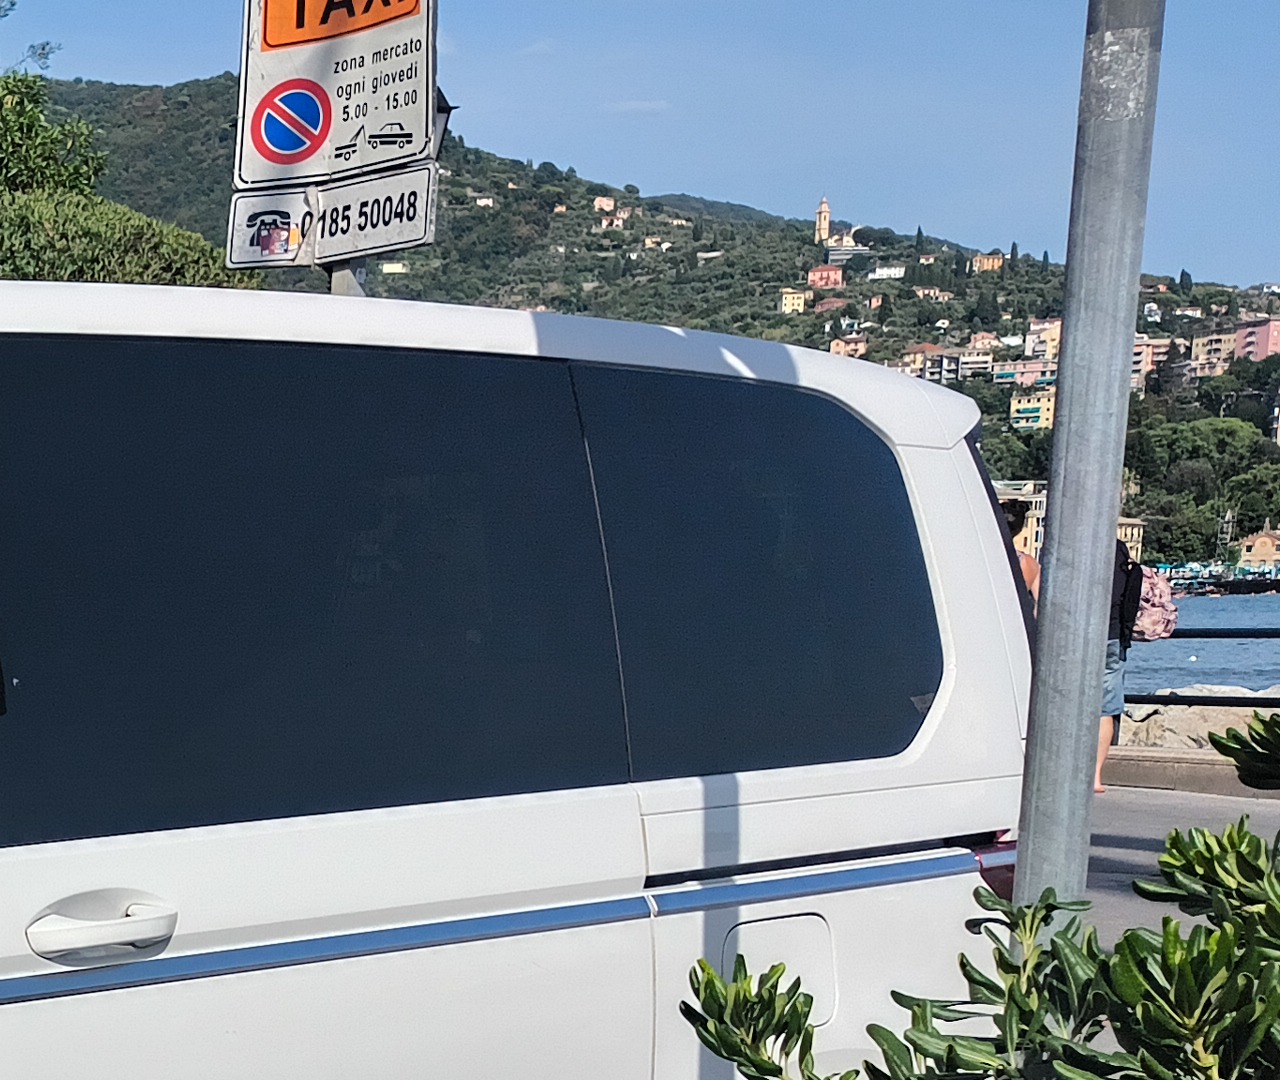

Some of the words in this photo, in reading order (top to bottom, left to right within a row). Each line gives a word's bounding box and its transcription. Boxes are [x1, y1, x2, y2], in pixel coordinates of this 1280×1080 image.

[333, 55, 365, 75] zona
[371, 37, 423, 65] mercato
[336, 76, 366, 101] ogni
[342, 102, 368, 122] 5.00
[385, 89, 418, 111] 15.00
[300, 204, 351, 239] 0185
[357, 190, 418, 232] 50048
